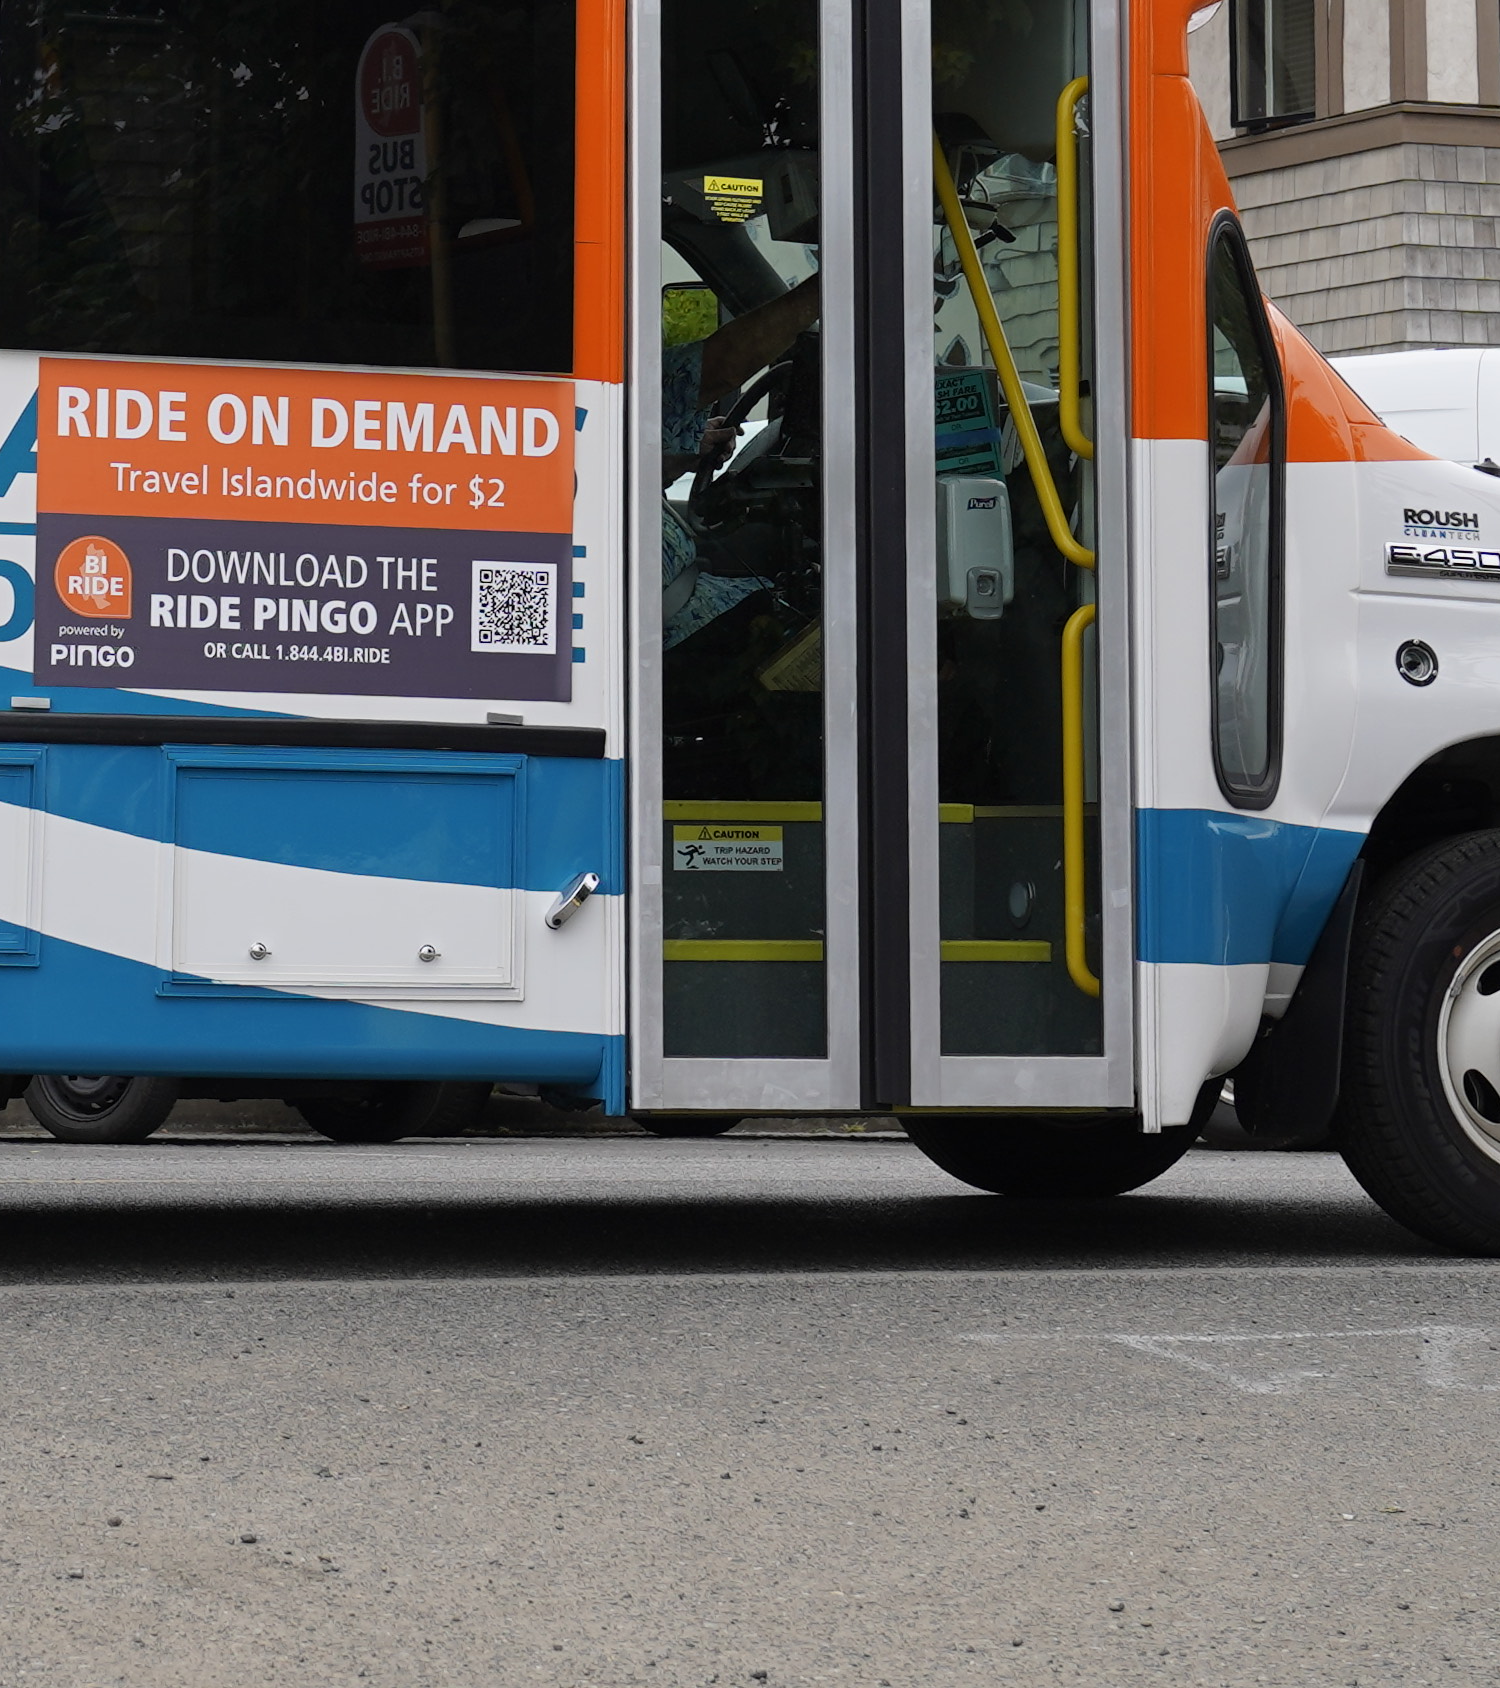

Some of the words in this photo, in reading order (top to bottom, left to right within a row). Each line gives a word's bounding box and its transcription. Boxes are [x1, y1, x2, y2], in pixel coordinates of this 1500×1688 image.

[721, 183, 759, 192] CAUTION
[58, 386, 187, 442] RIDE
[207, 393, 289, 446] ON
[311, 398, 560, 457] DEMAND
[110, 462, 208, 496] Travel
[222, 467, 397, 503] Islandwide
[408, 473, 457, 505] for
[469, 475, 505, 510] $2
[1404, 508, 1480, 528] ROUSH
[86, 555, 108, 575] BI
[167, 548, 368, 589] DOWNLOAD
[376, 556, 439, 592] THE
[68, 575, 124, 597] RIDE
[150, 593, 241, 630] RIDE
[253, 598, 377, 635] PINGO
[389, 602, 455, 637] APP
[59, 624, 108, 637] powered
[111, 625, 125, 639] by
[204, 642, 227, 659] OR
[231, 642, 270, 660] CALL
[276, 644, 391, 664] 1.844.4BI.RIDE
[713, 830, 760, 839] CAUTION
[714, 846, 734, 855] TRIP
[735, 846, 771, 855] HAZARD
[702, 857, 733, 865] WATCH
[735, 857, 759, 865] YOUR
[760, 857, 783, 866] STEP
